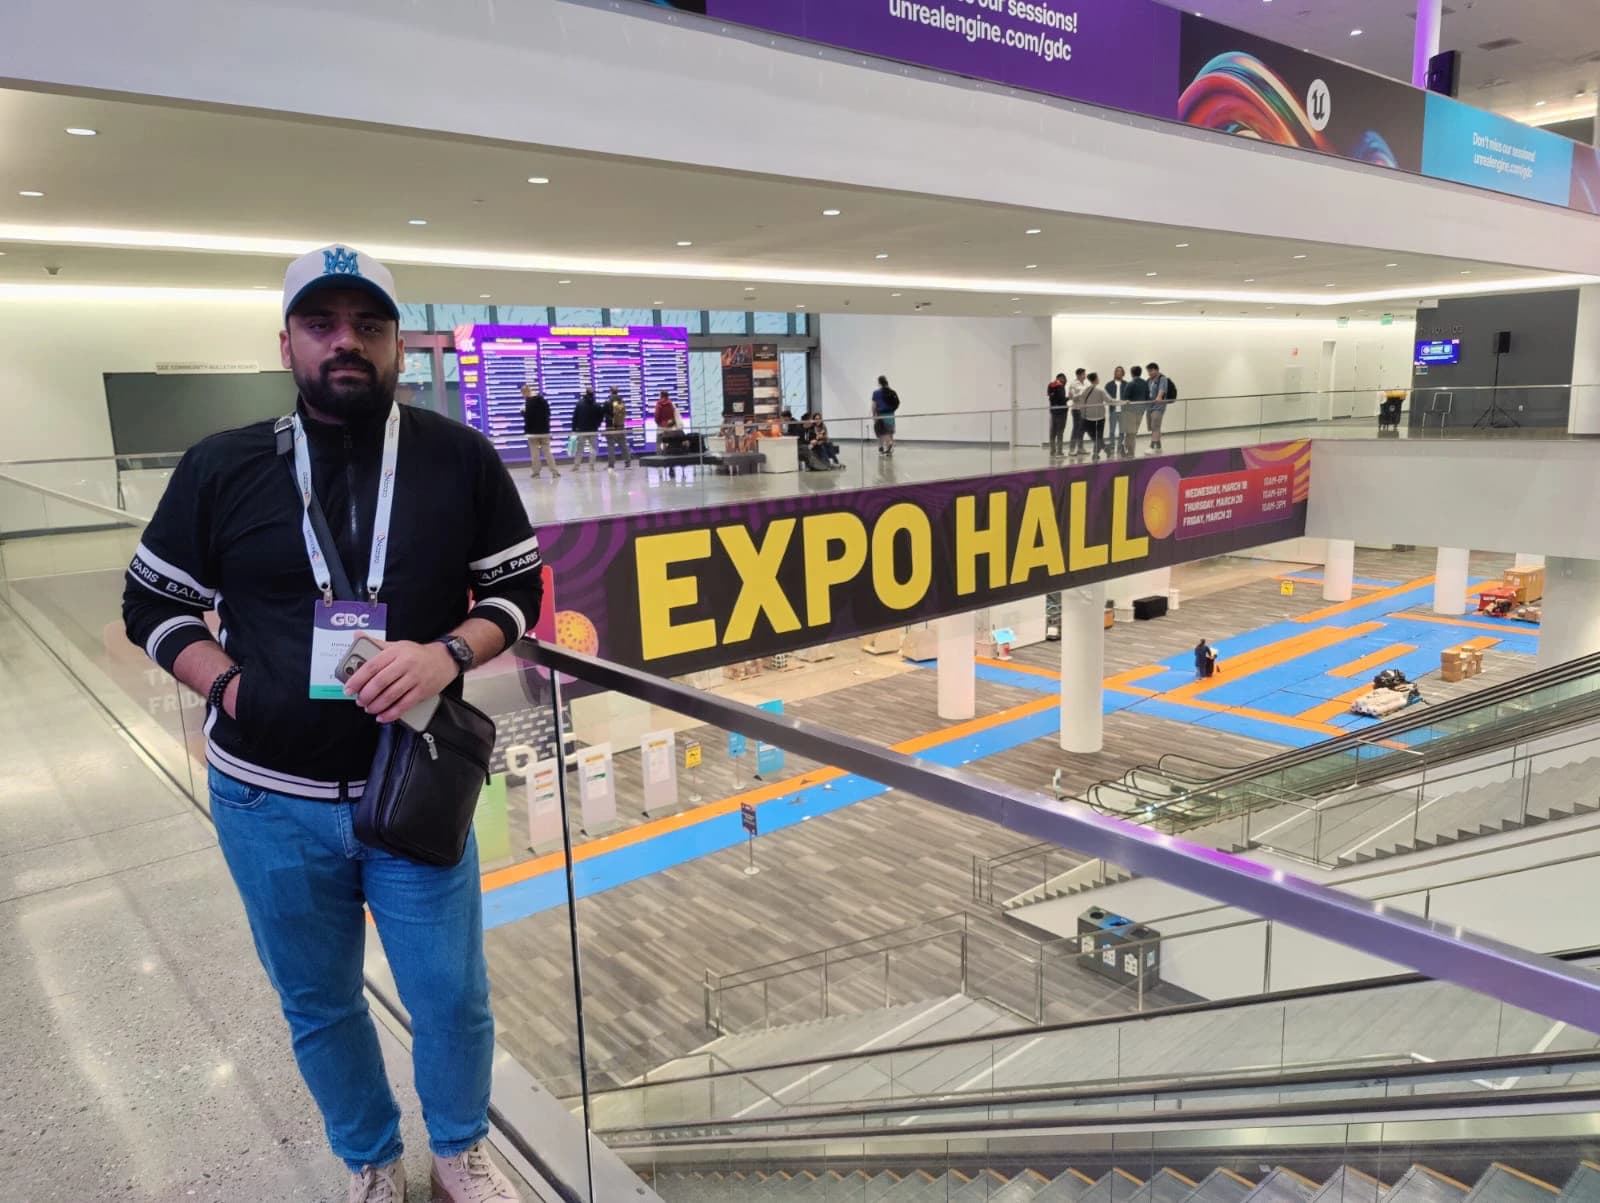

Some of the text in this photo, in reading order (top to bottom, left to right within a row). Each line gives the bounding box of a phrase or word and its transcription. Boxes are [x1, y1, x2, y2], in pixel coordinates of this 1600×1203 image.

[1007, 0, 1077, 33] sessions!
[889, 0, 1072, 61] unrealengine.com/gdc
[1216, 495, 1235, 507] MARCH
[1206, 510, 1226, 522] MARCH
[131, 557, 160, 583] PARIS
[509, 551, 538, 570] PARIS
[634, 475, 1150, 661] EXPO HALL
[330, 612, 370, 628] GDC
